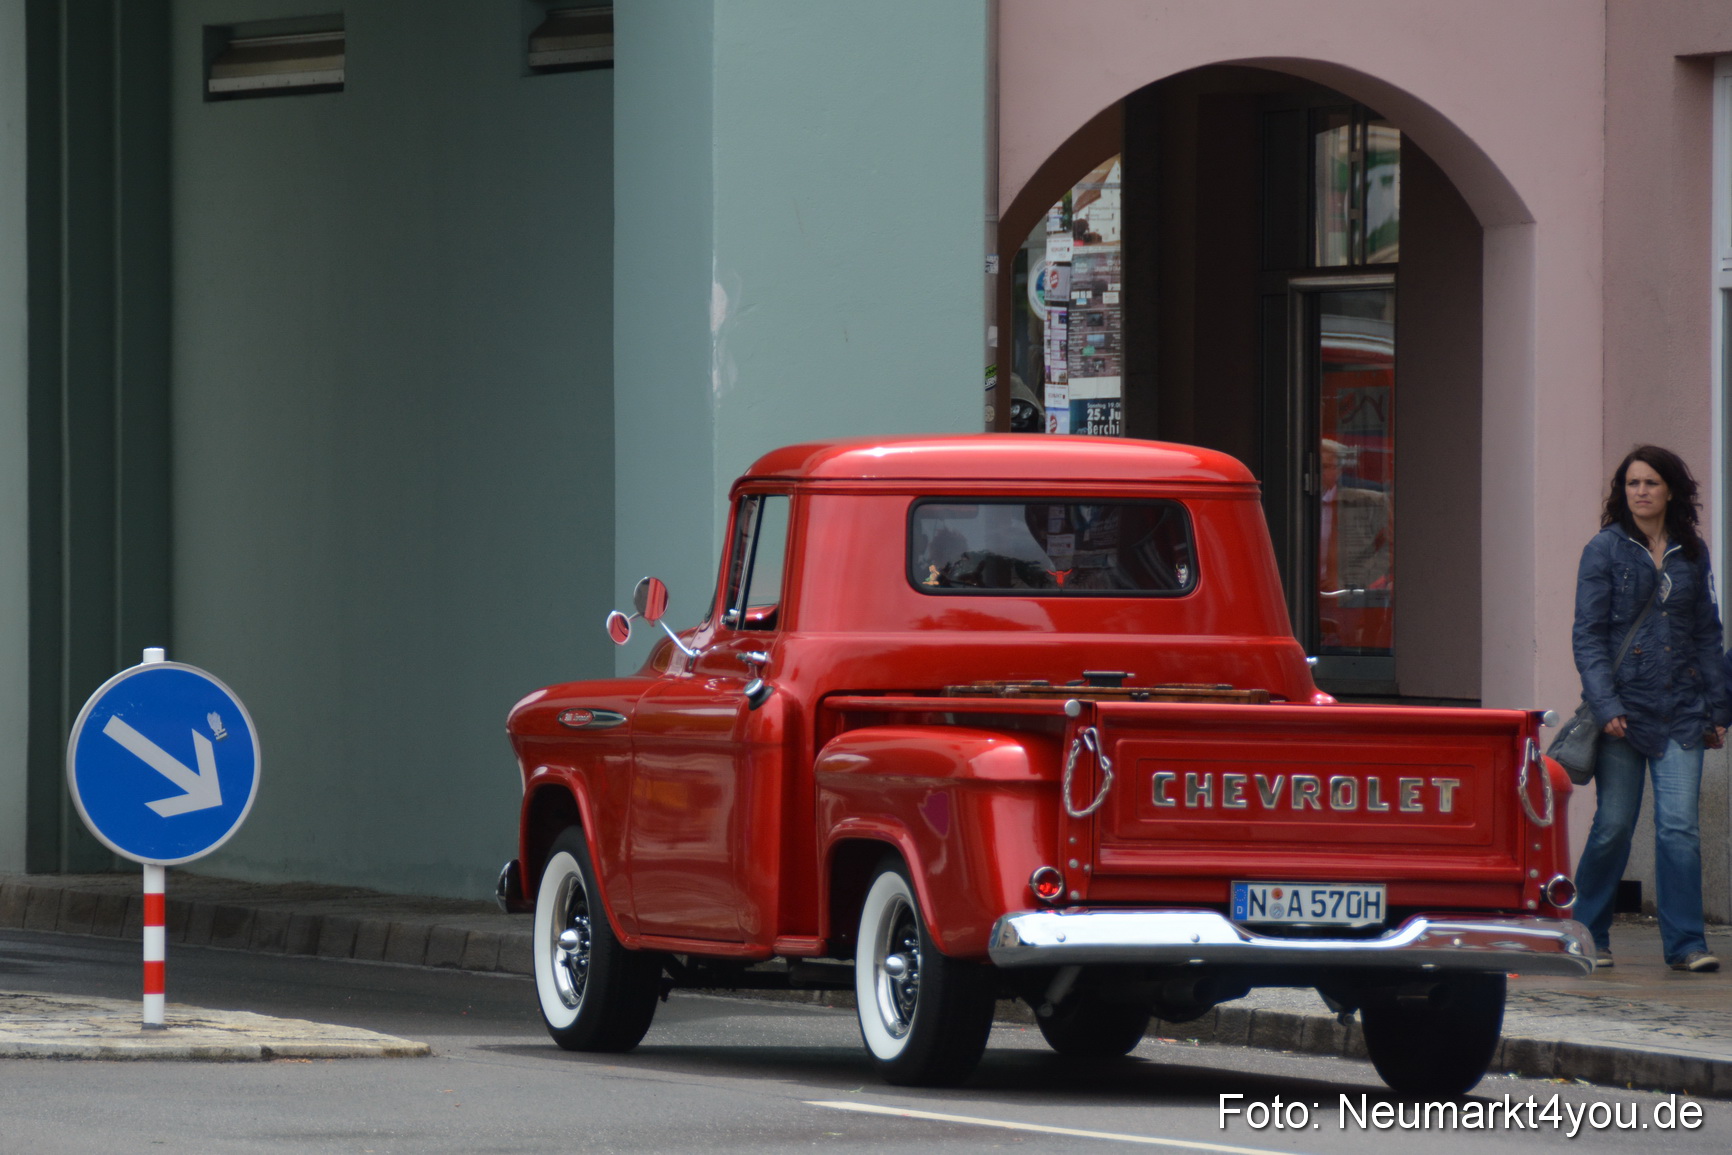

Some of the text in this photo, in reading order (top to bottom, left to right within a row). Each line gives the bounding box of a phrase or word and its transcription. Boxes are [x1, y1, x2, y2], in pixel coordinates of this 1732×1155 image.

[1087, 408, 1105, 421] 25.
[1152, 772, 1460, 813] CHEVROLET
[1236, 889, 1381, 919] D N A 570H
